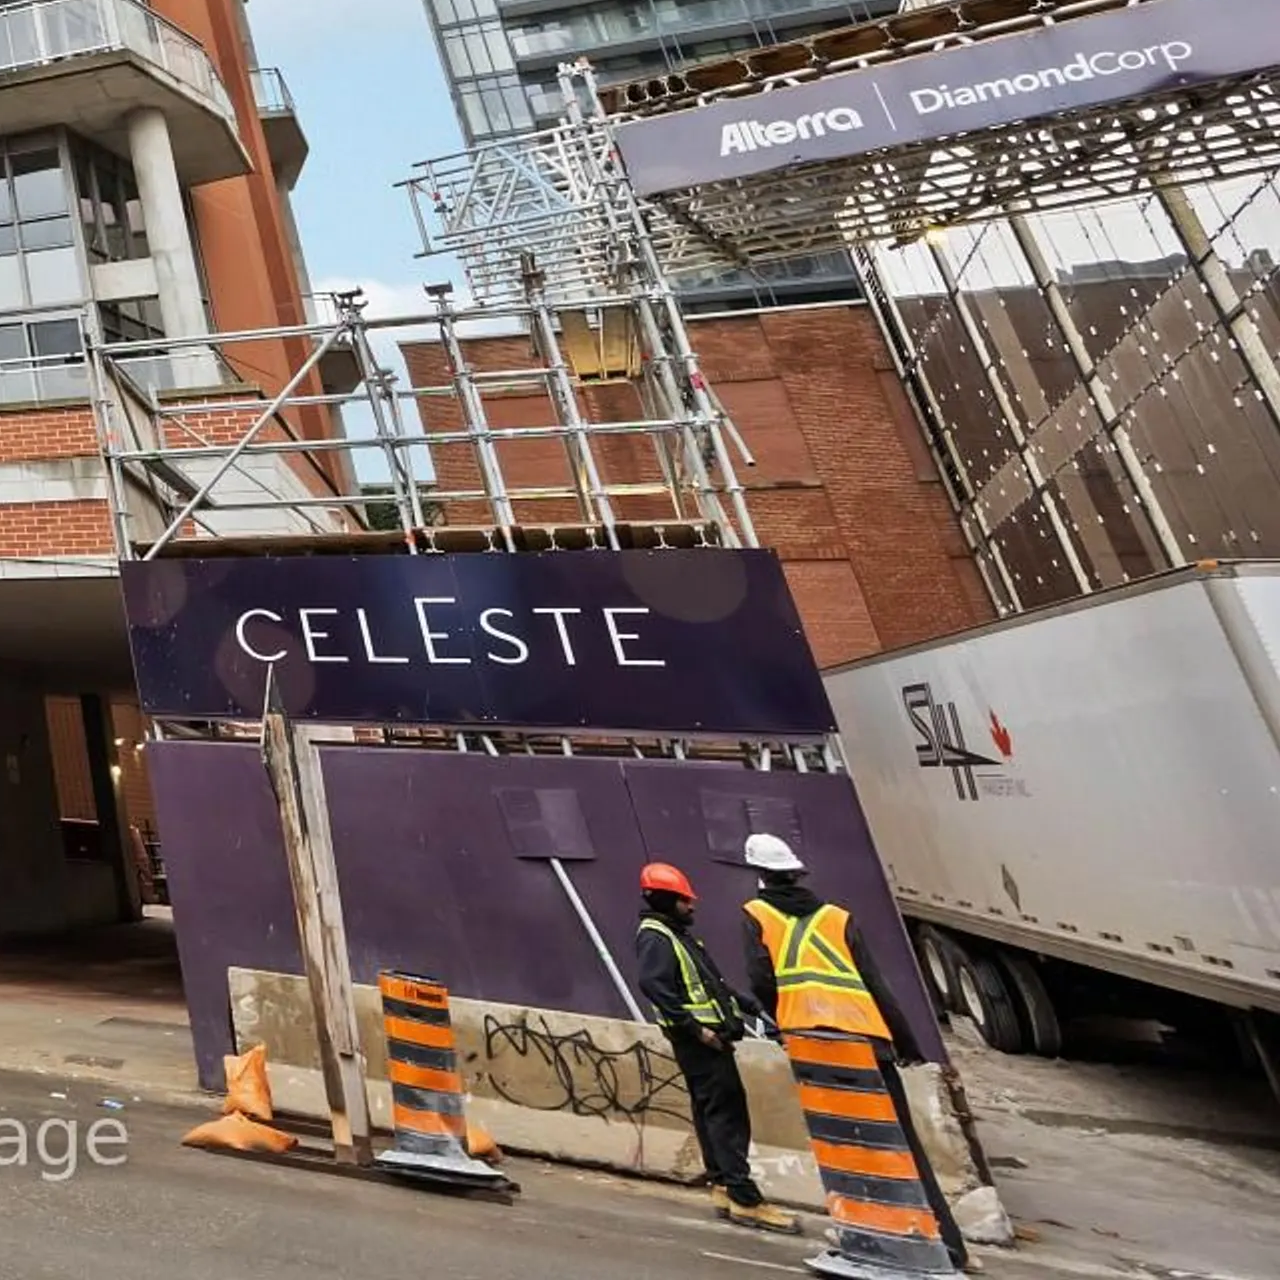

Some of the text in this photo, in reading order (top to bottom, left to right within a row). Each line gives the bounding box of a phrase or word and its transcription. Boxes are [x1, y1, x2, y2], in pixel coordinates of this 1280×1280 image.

[720, 40, 1193, 157] Alterra DiamondCorp
[235, 597, 666, 667] CELESTE
